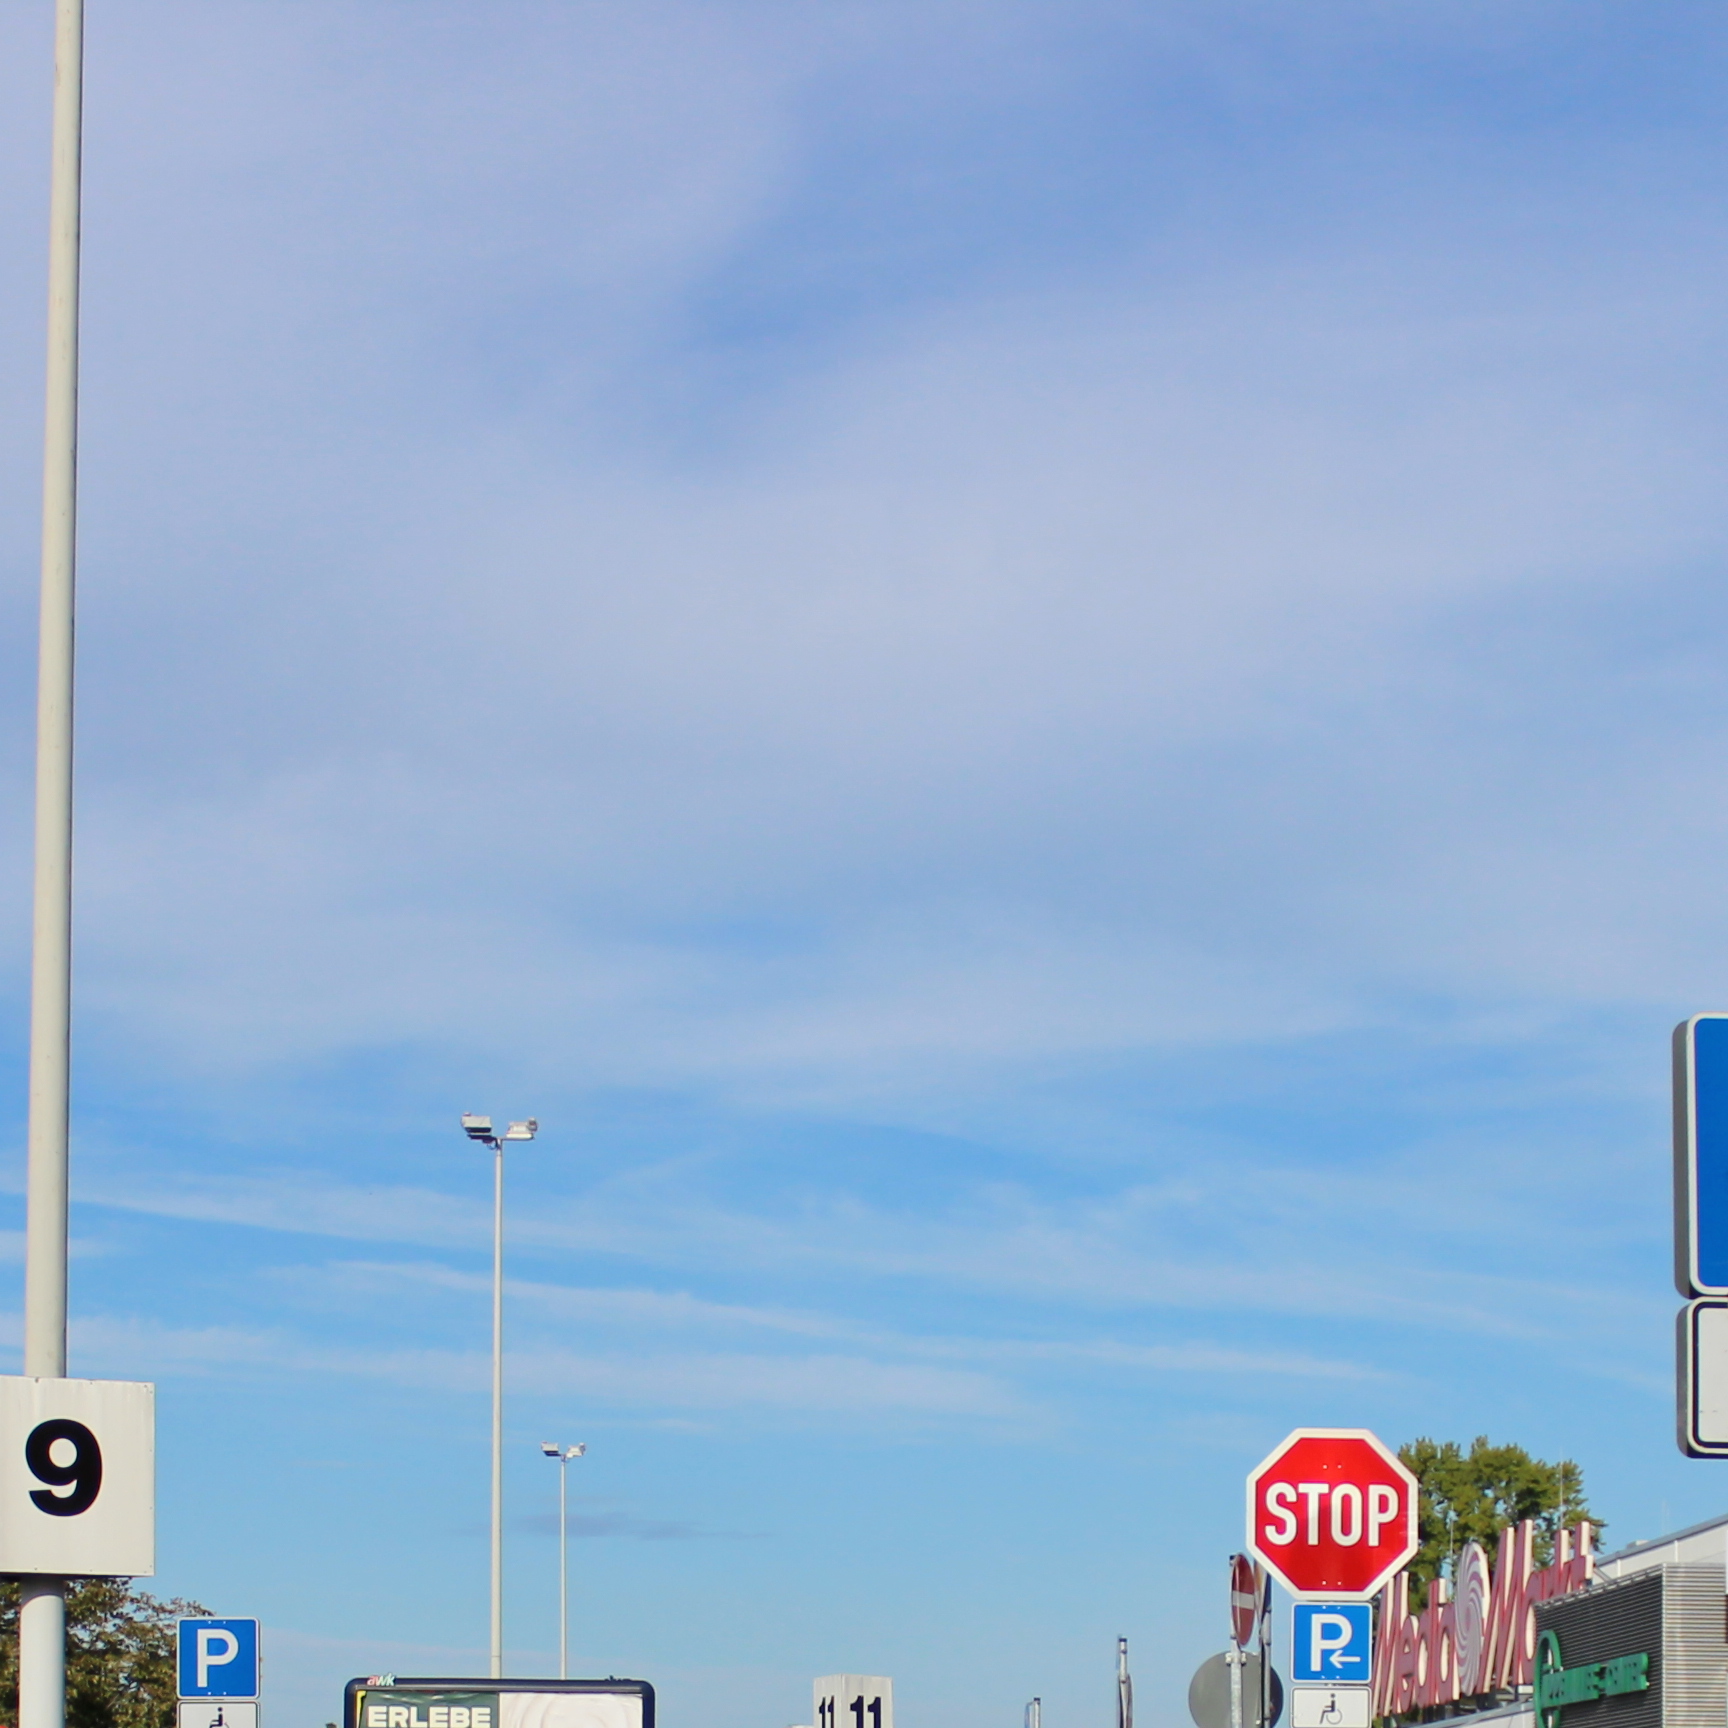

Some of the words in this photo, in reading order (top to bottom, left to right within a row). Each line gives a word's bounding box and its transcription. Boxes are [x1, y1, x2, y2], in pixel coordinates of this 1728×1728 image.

[25, 1418, 103, 1517] 9
[1265, 1481, 1400, 1547] STOP
[196, 1628, 239, 1688] P
[1310, 1613, 1353, 1672] P
